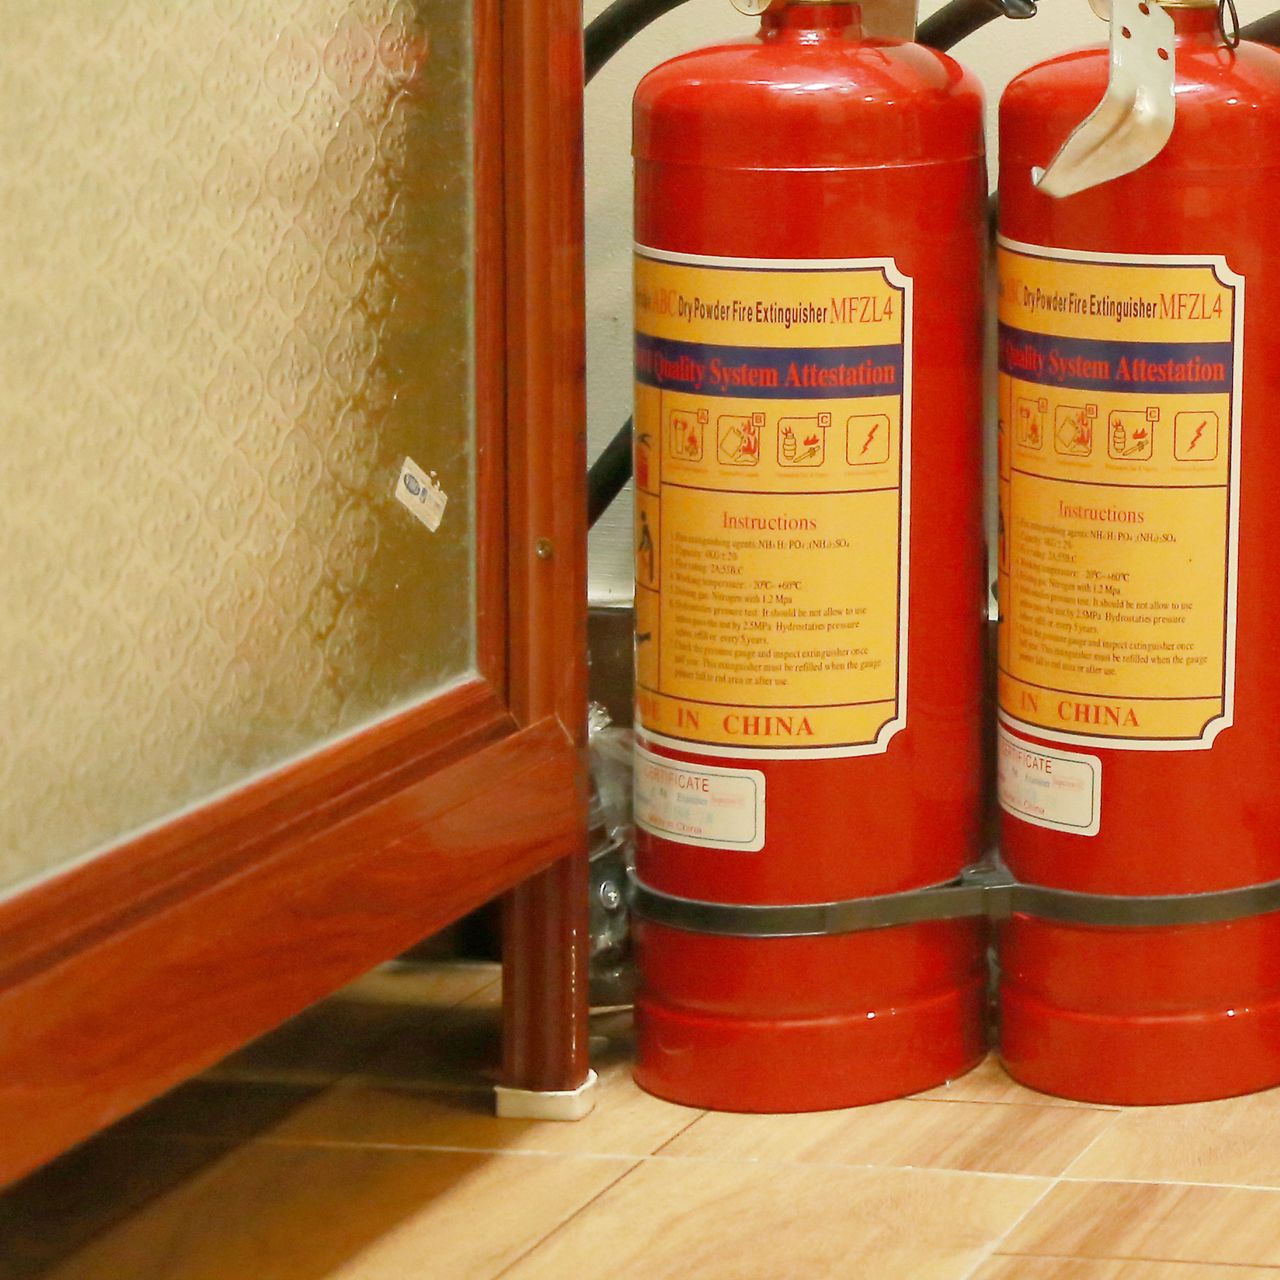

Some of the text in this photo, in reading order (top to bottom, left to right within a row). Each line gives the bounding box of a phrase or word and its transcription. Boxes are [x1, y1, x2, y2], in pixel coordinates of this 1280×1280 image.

[678, 295, 692, 323] Dry
[694, 297, 730, 321] Powder
[733, 300, 753, 321] Fire
[756, 302, 827, 328] Extinguisher
[830, 296, 893, 324] MFZL4
[1037, 288, 1066, 312] Powder
[1069, 292, 1087, 315] Fire
[1090, 294, 1157, 322] Extinguisher
[1159, 293, 1222, 320] MFZL4
[710, 358, 777, 392] System
[785, 360, 896, 387] Attestation
[1049, 351, 1110, 383] System
[1116, 355, 1225, 382] Attestation
[723, 512, 817, 531] Instructions
[1059, 501, 1144, 523] Instructions
[677, 707, 699, 730] IN
[723, 714, 814, 736] CHINA
[1058, 700, 1140, 728] CHINA
